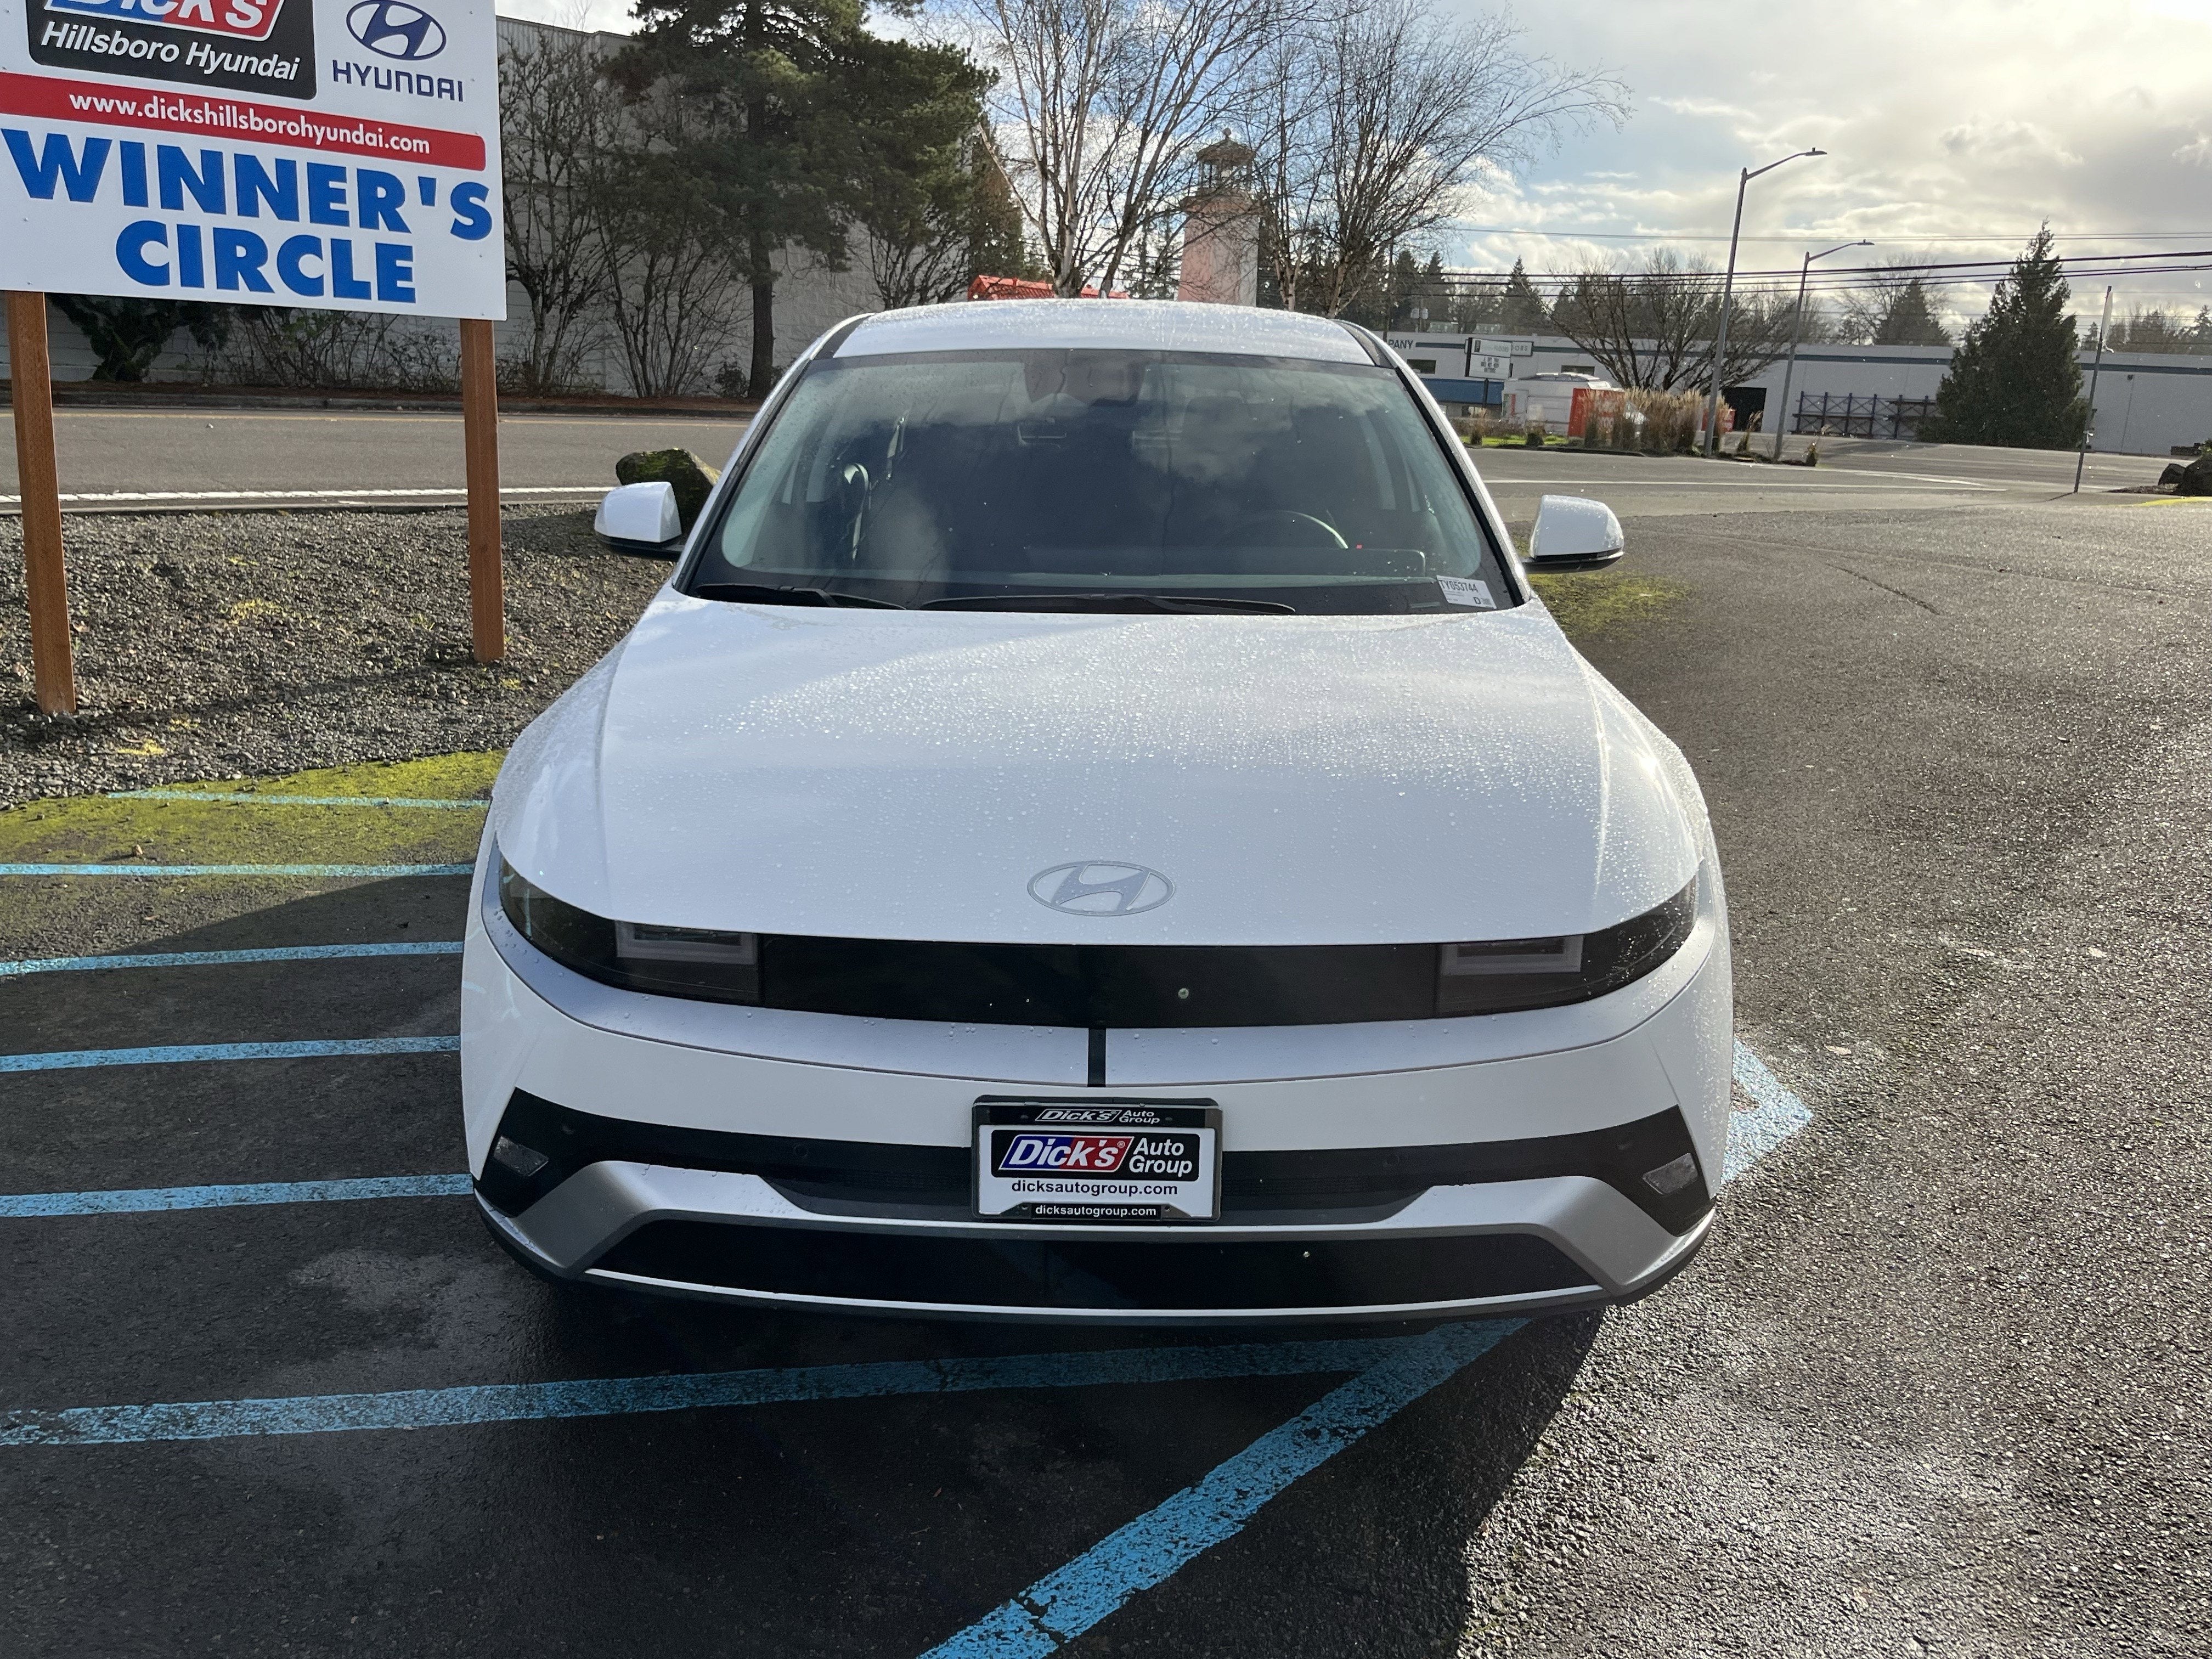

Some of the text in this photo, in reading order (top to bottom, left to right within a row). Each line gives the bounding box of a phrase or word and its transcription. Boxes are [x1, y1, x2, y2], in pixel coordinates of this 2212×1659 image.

[42, 21, 300, 81] Hillsboro Hyundai
[332, 60, 463, 102] HYUNDAI
[70, 94, 430, 154] www.dickshillsborohyundai.com
[1, 128, 492, 240] WINNER'S
[116, 220, 416, 303] CIRCLE
[1128, 1155, 1193, 1177] Group
[1133, 1138, 1184, 1156] Auto
[1012, 1180, 1178, 1197] dicksautogroup.com
[1035, 1205, 1156, 1217] dicksautogroup.com
